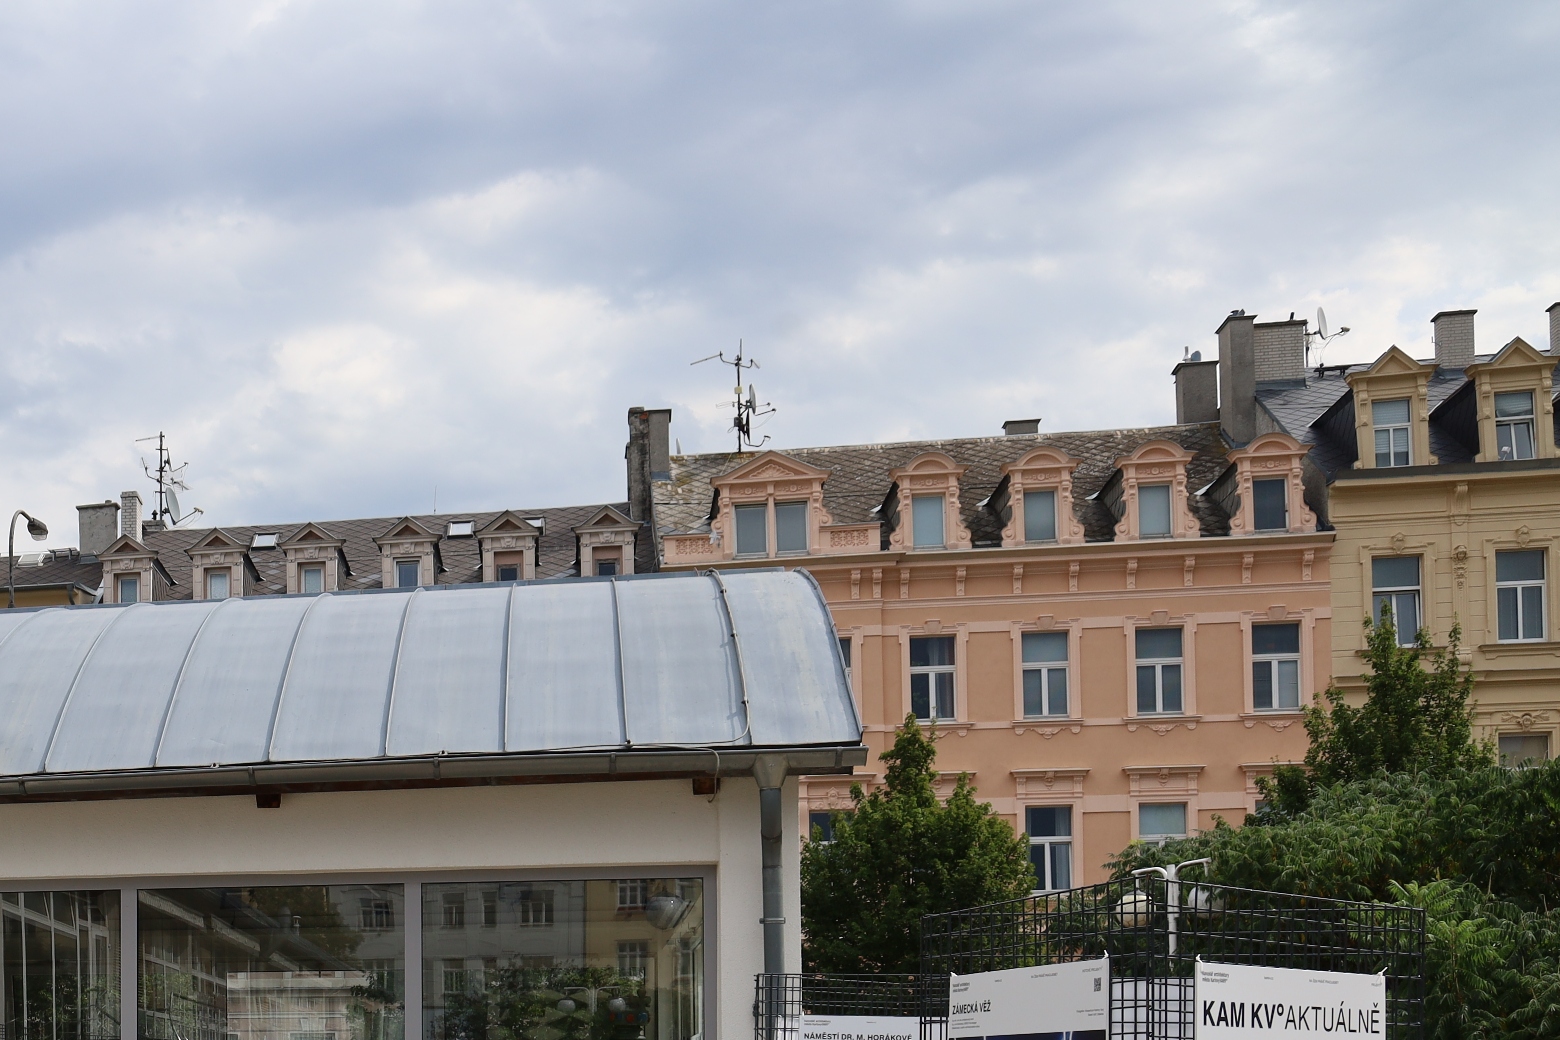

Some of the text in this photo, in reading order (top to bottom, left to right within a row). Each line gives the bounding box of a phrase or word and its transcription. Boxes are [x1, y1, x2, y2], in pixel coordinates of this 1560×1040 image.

[952, 999, 991, 1015] ZÁMECKÁ VĚŽ
[1203, 1000, 1245, 1028] KAM
[804, 1031, 840, 1040] NÁMĚSTÍ
[841, 1033, 855, 1040] DR.
